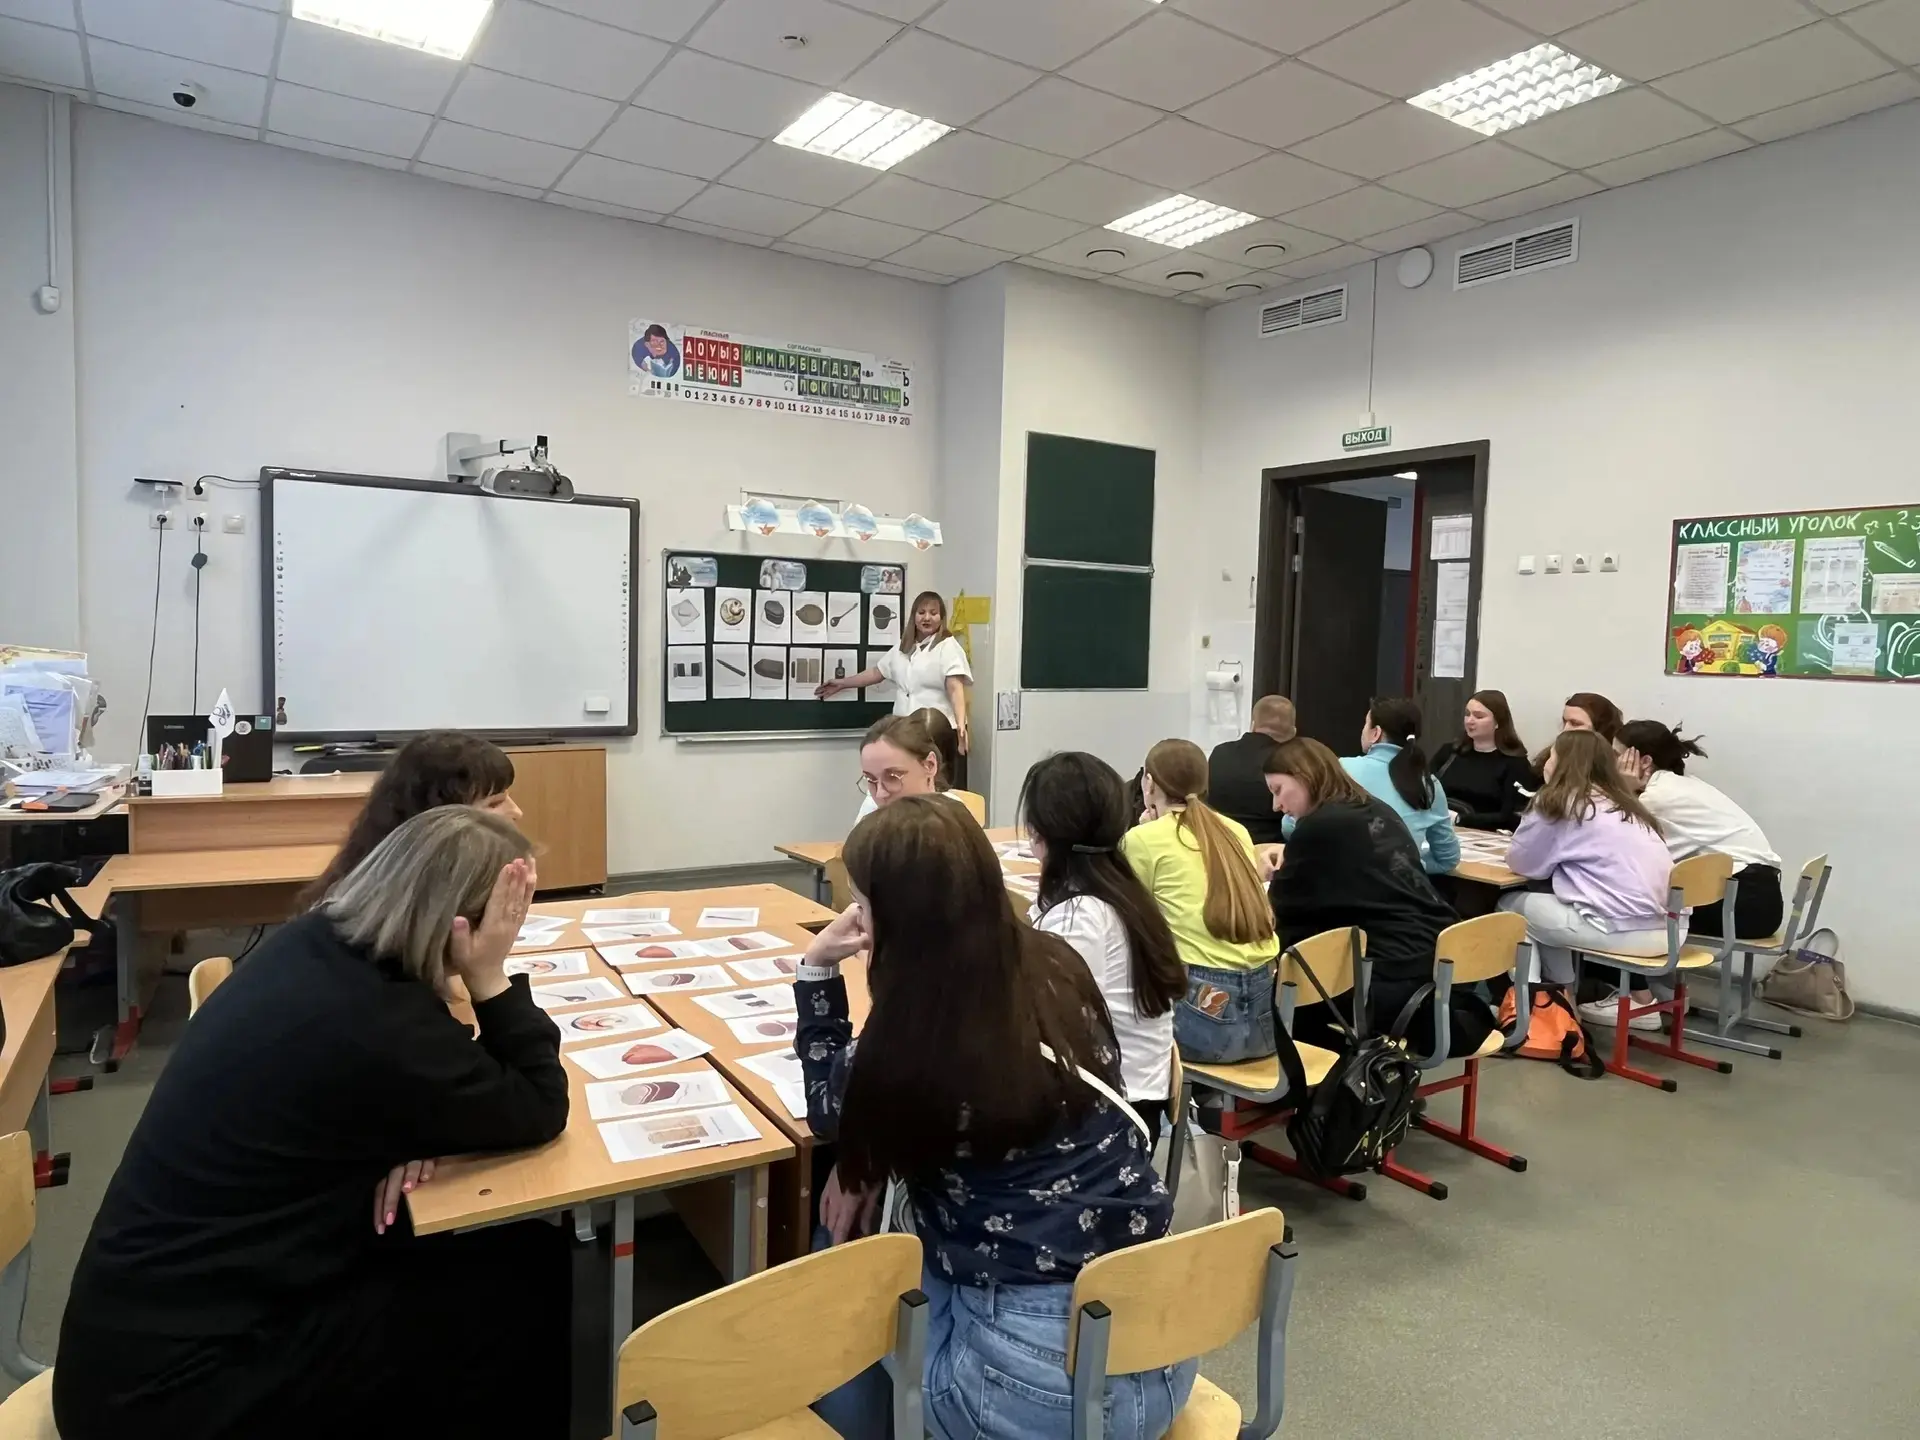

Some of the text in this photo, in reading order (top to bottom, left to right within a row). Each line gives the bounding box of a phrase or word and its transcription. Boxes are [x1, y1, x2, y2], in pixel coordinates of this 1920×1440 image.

[684, 390, 692, 399] 0
[694, 391, 700, 400] 1
[702, 392, 709, 401] 2
[711, 393, 718, 402] 3
[720, 395, 727, 403] 4
[730, 395, 736, 404] 5
[738, 397, 746, 406] 6
[748, 398, 754, 406] 7
[756, 399, 763, 408] 8
[765, 400, 772, 409] 9
[774, 401, 785, 410] 10
[787, 403, 798, 412] 11
[800, 404, 811, 413] 12
[813, 406, 823, 415] 13
[825, 406, 837, 416] 14
[839, 409, 849, 418] 15
[851, 411, 862, 420] 16
[864, 412, 874, 421] 17
[876, 414, 886, 422] 18
[888, 415, 898, 425] 19
[899, 417, 911, 426] 20
[1345, 429, 1383, 445] ВЫХОД
[1679, 512, 1862, 539] КЛАССНЫЙ УГОЛОК
[1896, 510, 1908, 526] 2
